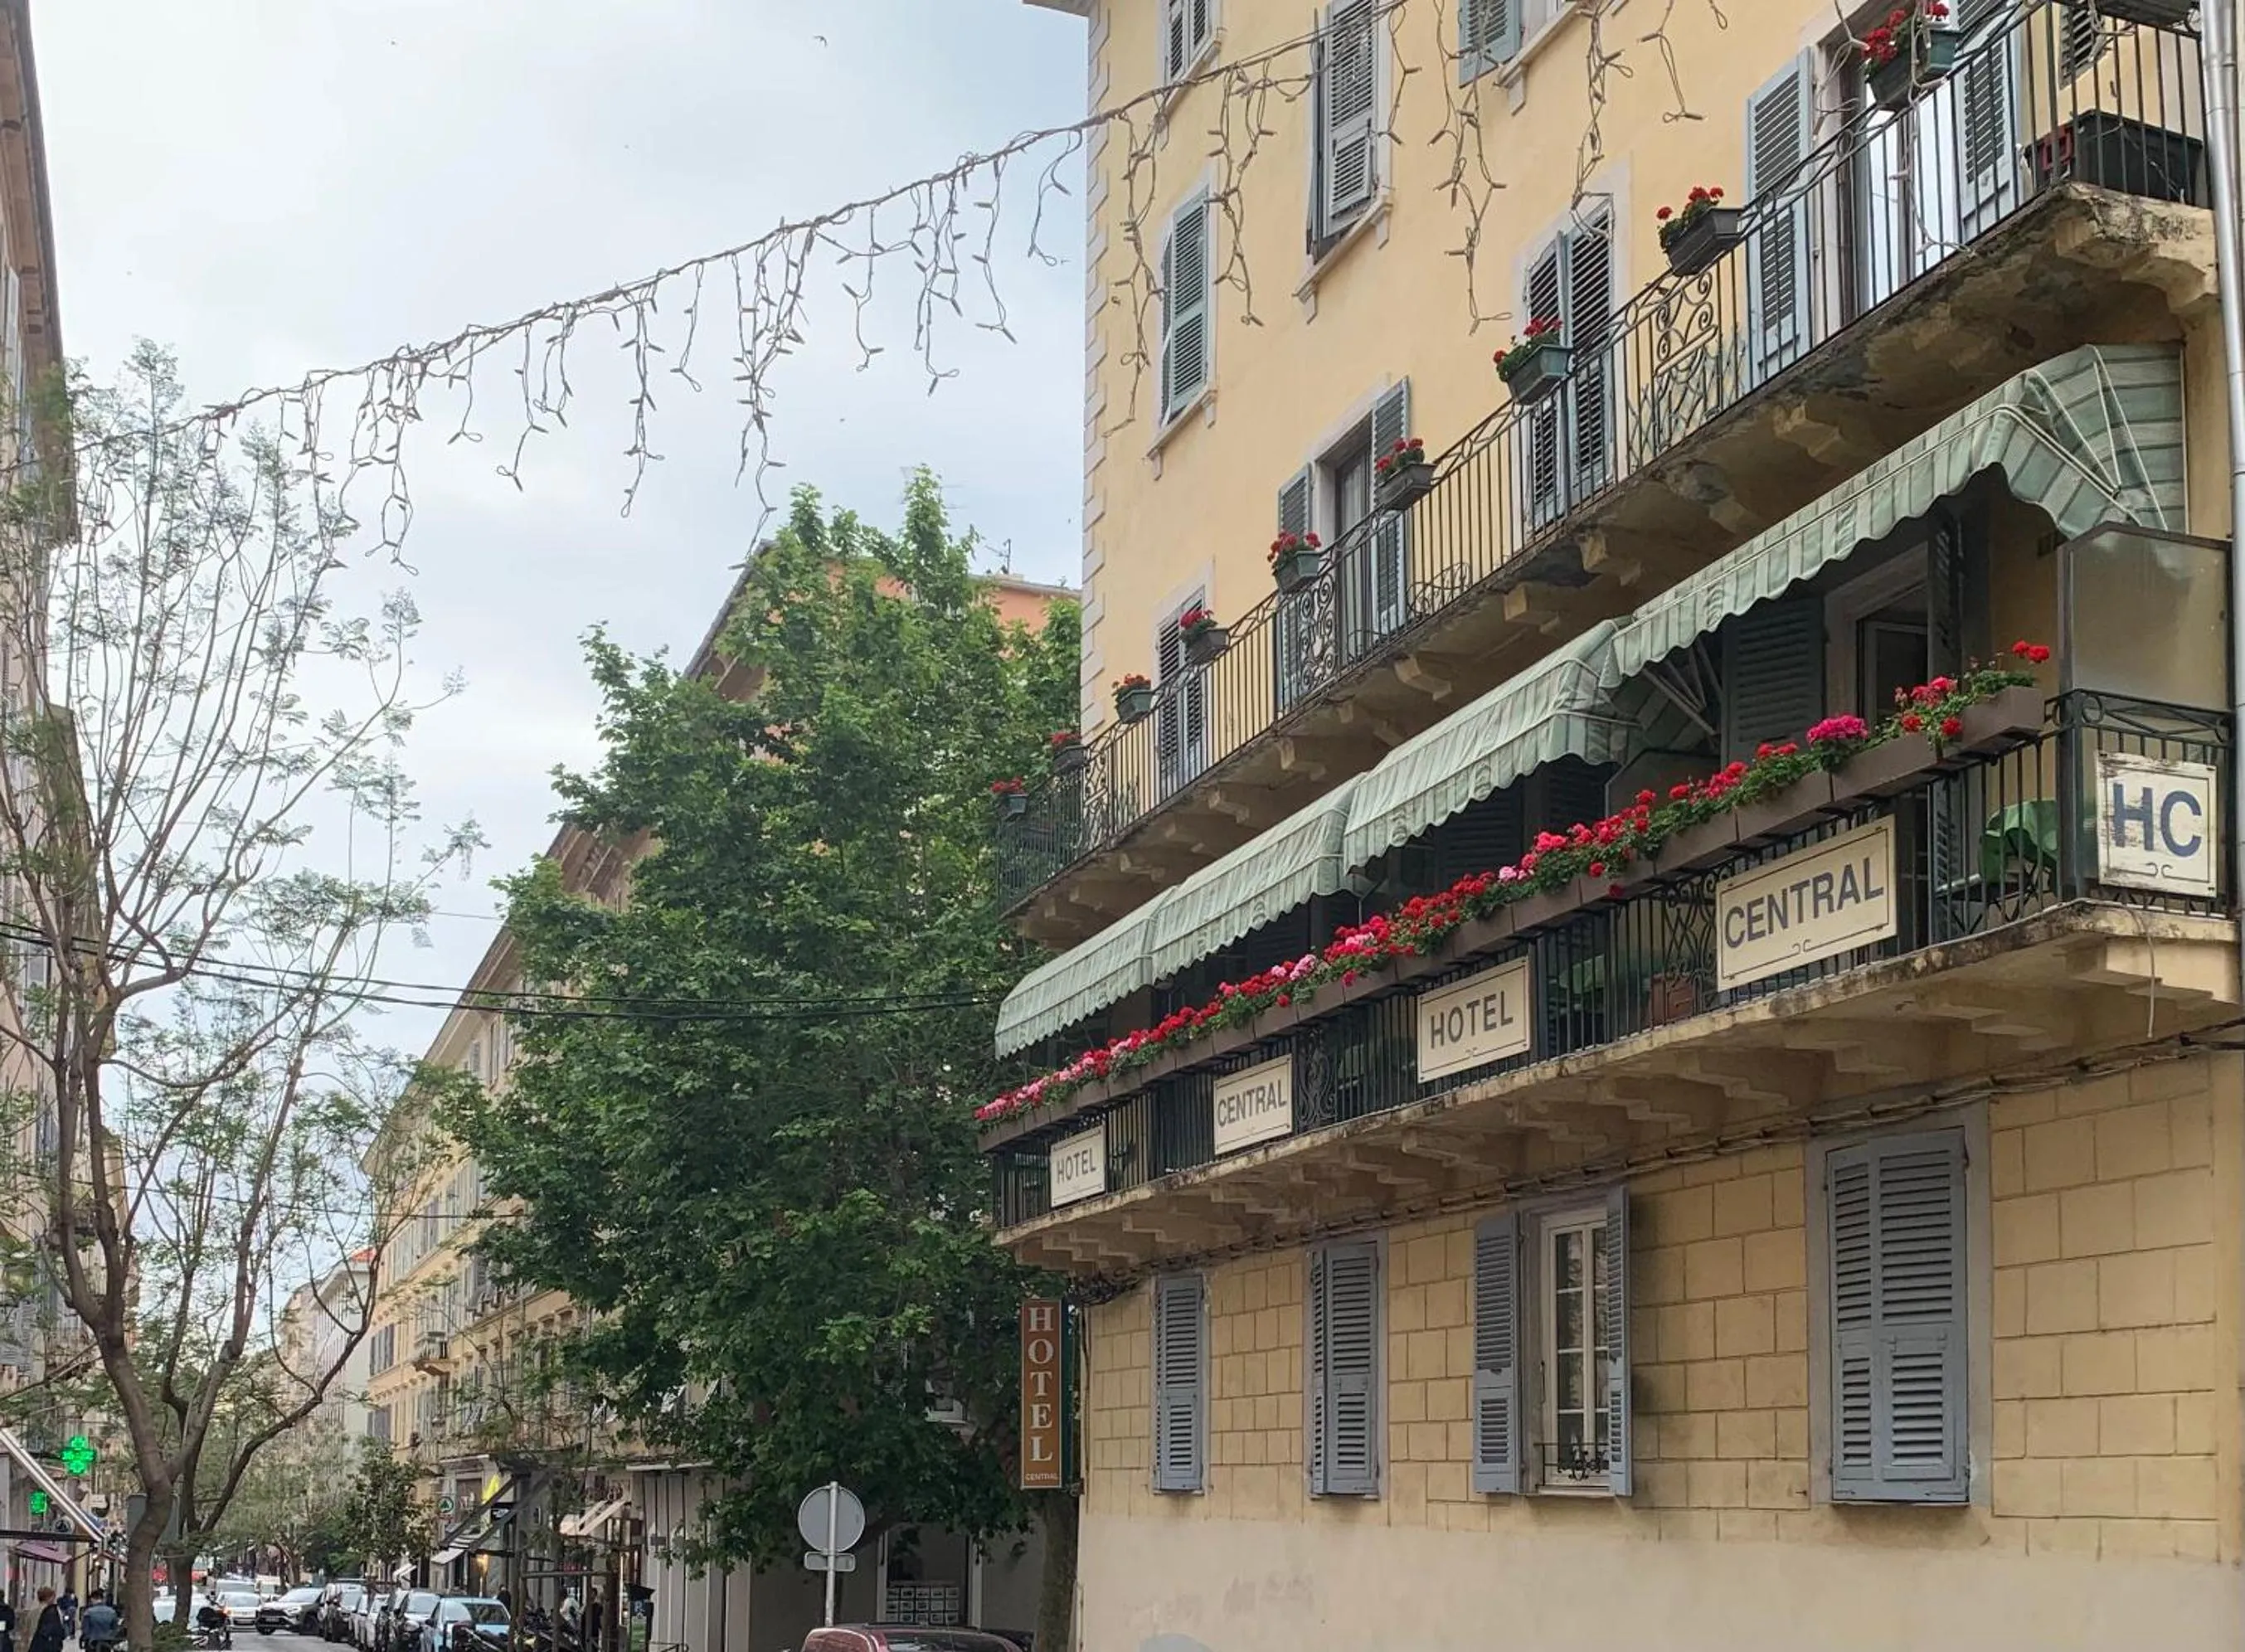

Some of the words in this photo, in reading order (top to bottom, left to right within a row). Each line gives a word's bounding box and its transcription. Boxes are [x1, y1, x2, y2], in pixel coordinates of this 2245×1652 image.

[2112, 783, 2203, 858] HC
[1724, 857, 1885, 949] CENTRAL
[1430, 990, 1514, 1050] HOTEL
[1217, 1079, 1287, 1128] CENTRAL
[1057, 1147, 1096, 1184] HOTEL
[1028, 1305, 1054, 1462] HOTEL
[1025, 1472, 1058, 1481] CENTRAL
